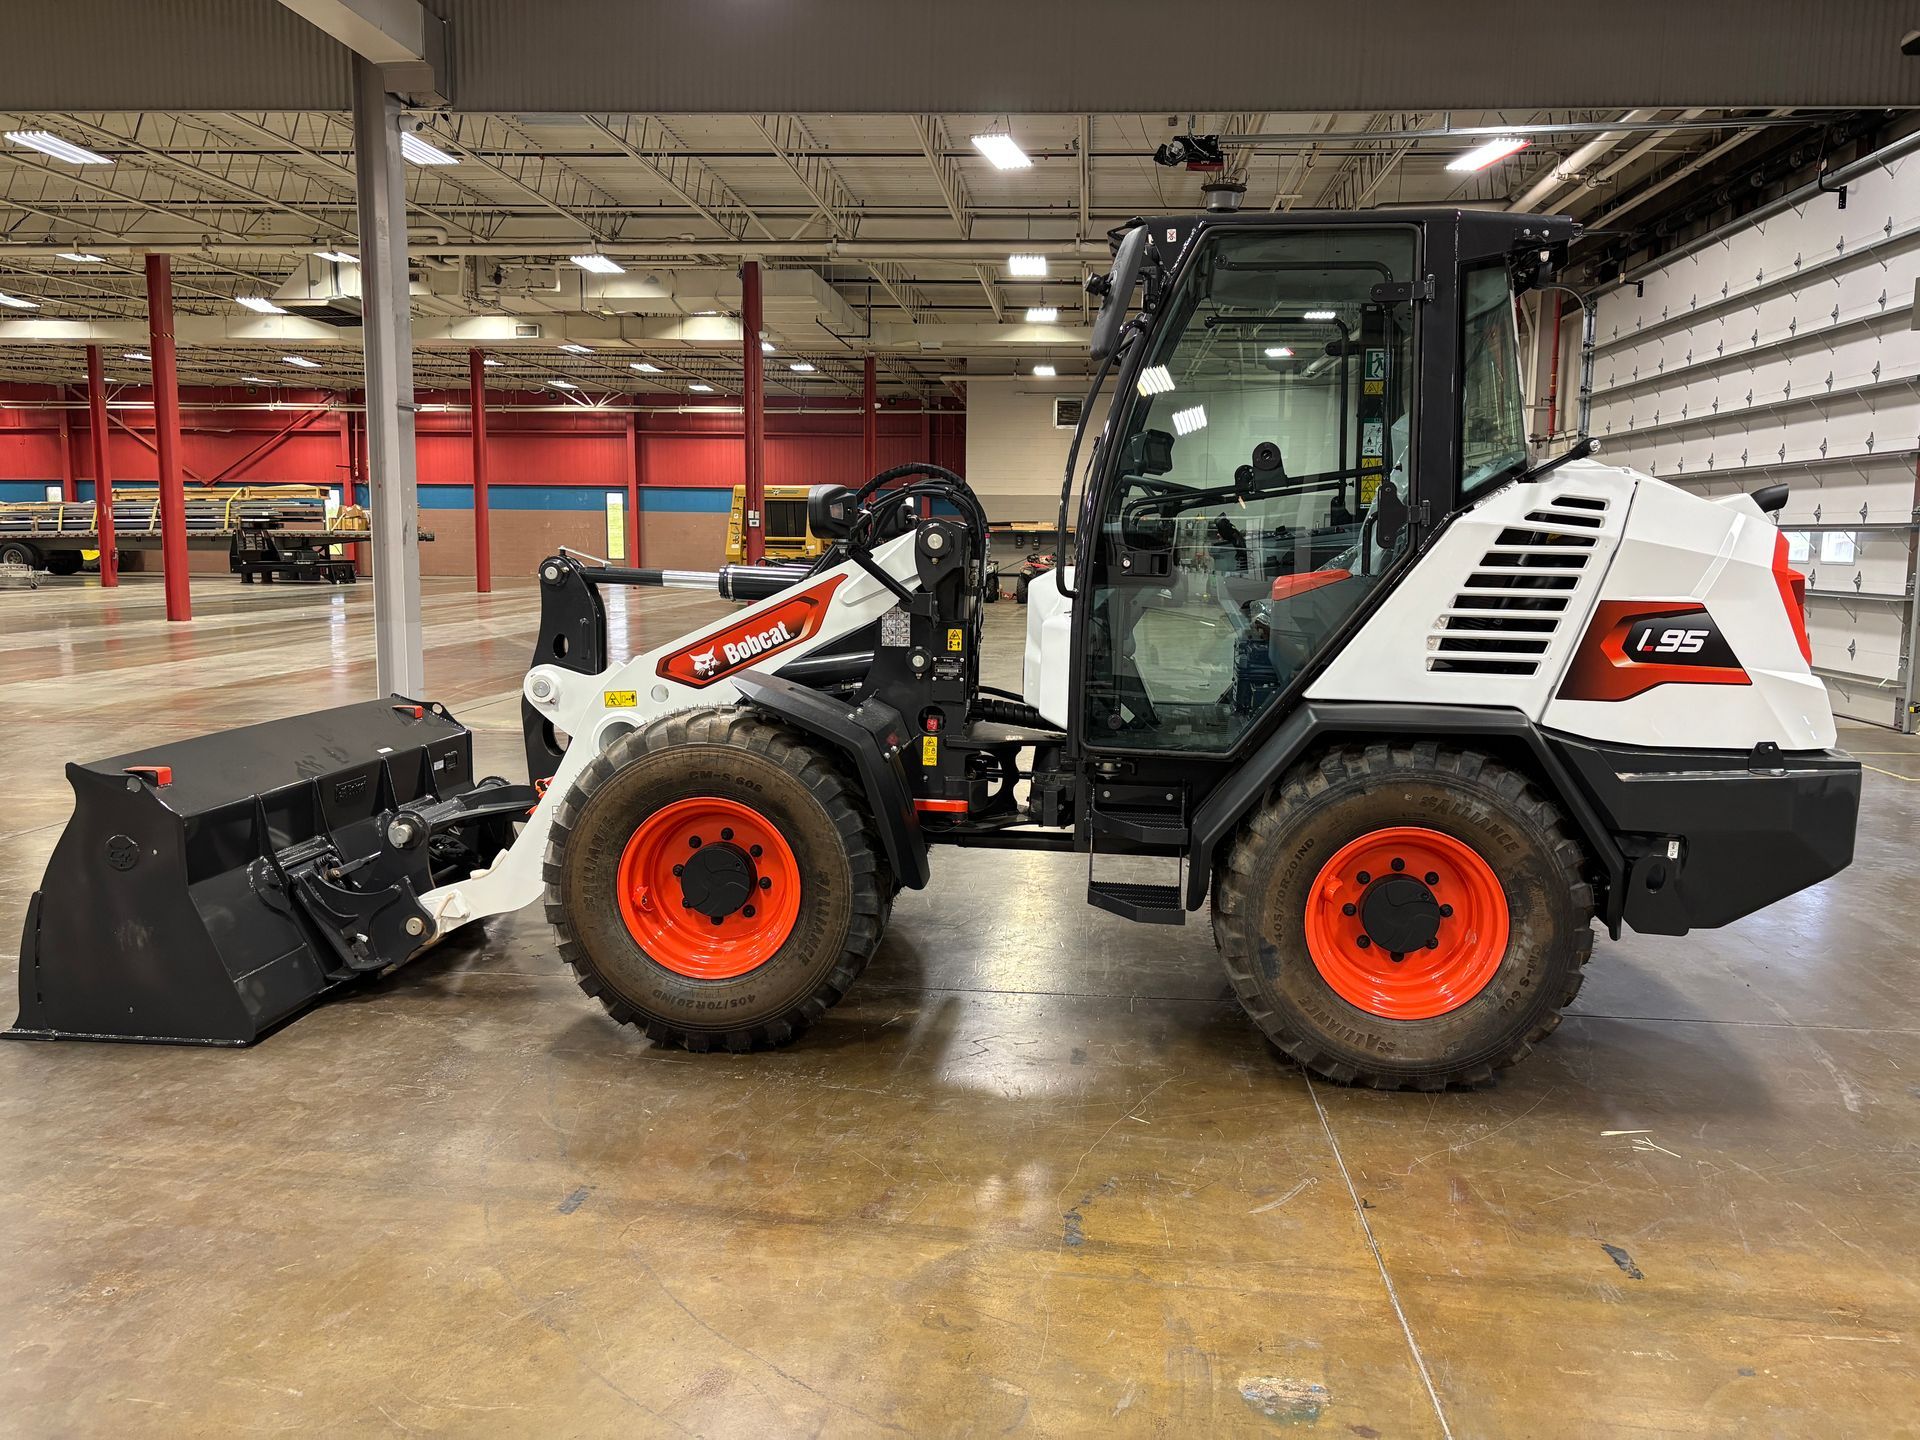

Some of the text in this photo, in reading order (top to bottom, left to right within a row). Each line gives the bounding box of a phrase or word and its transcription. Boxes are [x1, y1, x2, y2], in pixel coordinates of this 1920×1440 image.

[722, 620, 792, 666] Bobcat
[1431, 798, 1520, 854] ALLIANCE
[582, 814, 614, 898] ALLIANCE
[1297, 996, 1383, 1051] ALLIANCE
